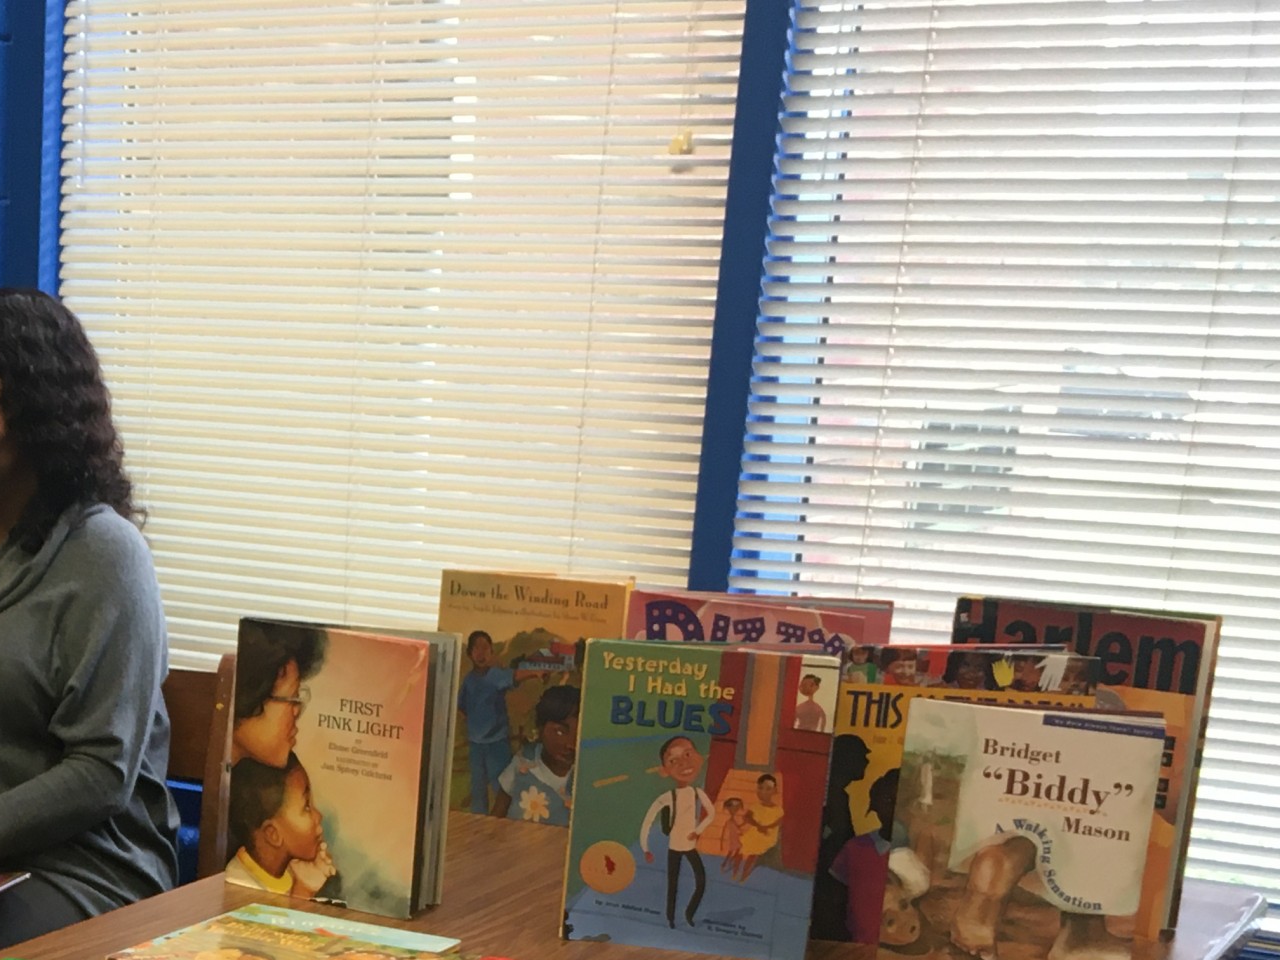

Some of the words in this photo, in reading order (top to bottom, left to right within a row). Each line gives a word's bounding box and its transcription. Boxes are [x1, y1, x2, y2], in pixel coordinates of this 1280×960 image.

[449, 580, 487, 599] Down
[491, 583, 509, 601] the
[514, 584, 570, 608] Winding
[575, 590, 609, 610] Road
[602, 651, 709, 681] Yesterday
[628, 674, 636, 693] I
[647, 674, 688, 697] Had
[698, 679, 736, 700] the
[339, 698, 384, 718] FIRST
[610, 694, 735, 736] BLUES
[846, 689, 905, 730] THIS
[317, 713, 353, 733] PINK
[356, 719, 404, 740] LIGHT
[982, 738, 1063, 766] Bridget
[1060, 816, 1131, 842] Mason
[994, 822, 1006, 835] A
[1012, 818, 1054, 865] Walking
[1043, 868, 1104, 911] Sensation
